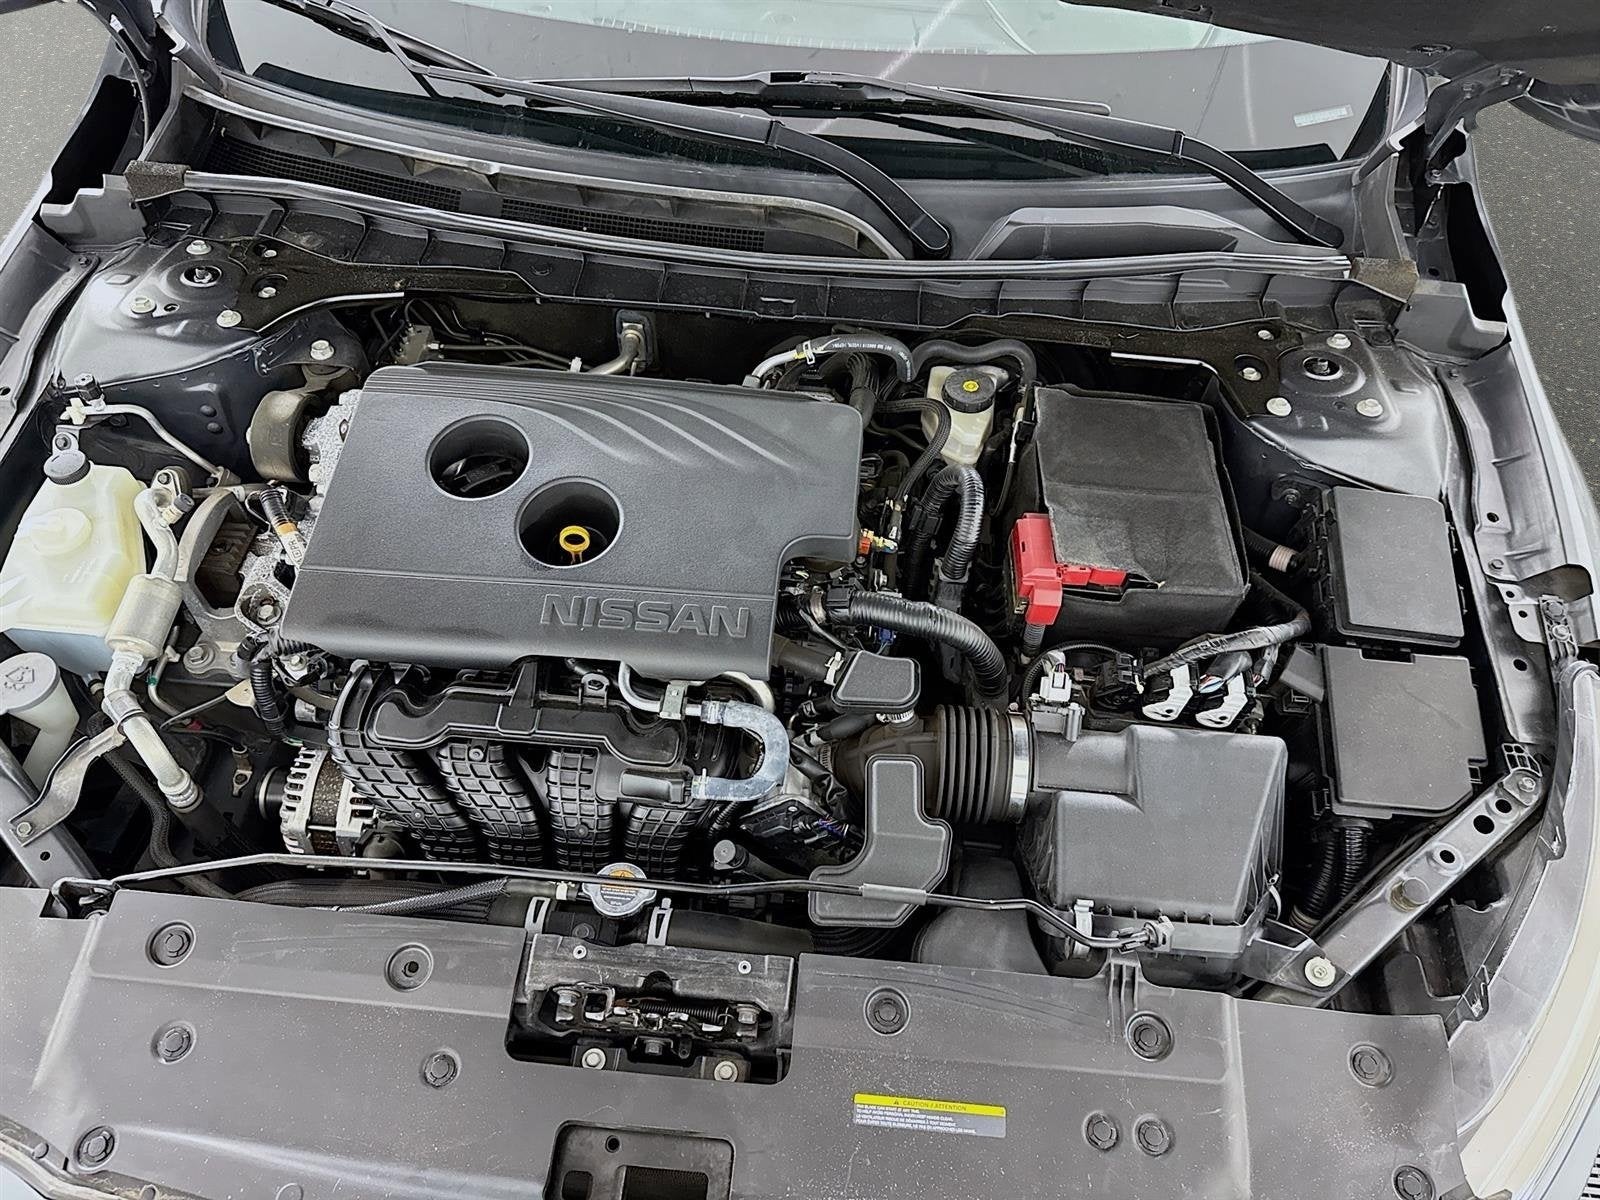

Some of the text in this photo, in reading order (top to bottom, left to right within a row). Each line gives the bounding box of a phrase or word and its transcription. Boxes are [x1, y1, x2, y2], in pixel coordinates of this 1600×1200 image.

[540, 593, 750, 638] NISSAN
[902, 1100, 929, 1108] CAUTION
[935, 1103, 968, 1111] ATTENTION
